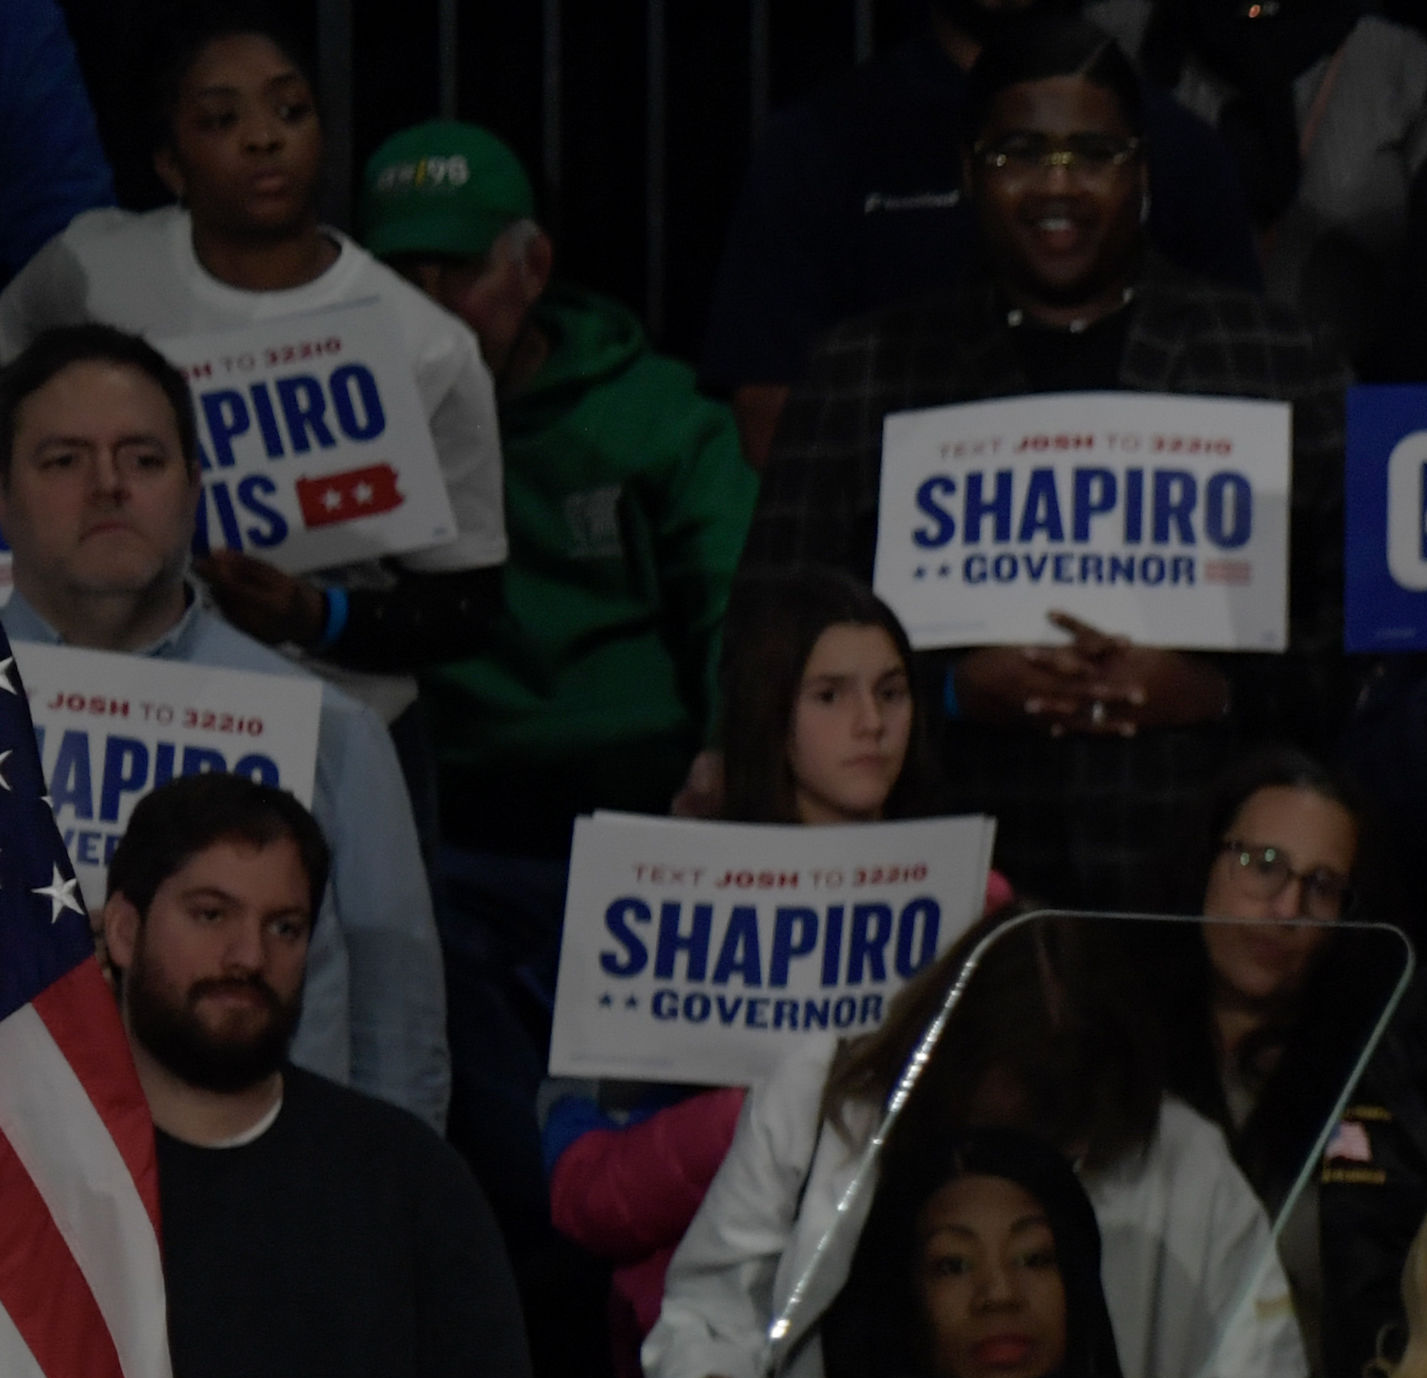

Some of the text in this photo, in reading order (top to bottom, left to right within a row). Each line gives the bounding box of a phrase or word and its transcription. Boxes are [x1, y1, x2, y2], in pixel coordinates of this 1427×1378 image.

[1014, 434, 1094, 454] JOSH
[1106, 434, 1140, 452] TO
[913, 467, 1253, 550] SHAPIRO
[962, 553, 1197, 586] GOVERNOR
[47, 691, 264, 737] JOSH TO 32210
[633, 864, 703, 885] TEXT
[714, 870, 798, 889] JOSH
[810, 872, 842, 889] TO
[599, 897, 941, 987] SHAPIRO
[651, 989, 883, 1030] GOVERNOR
